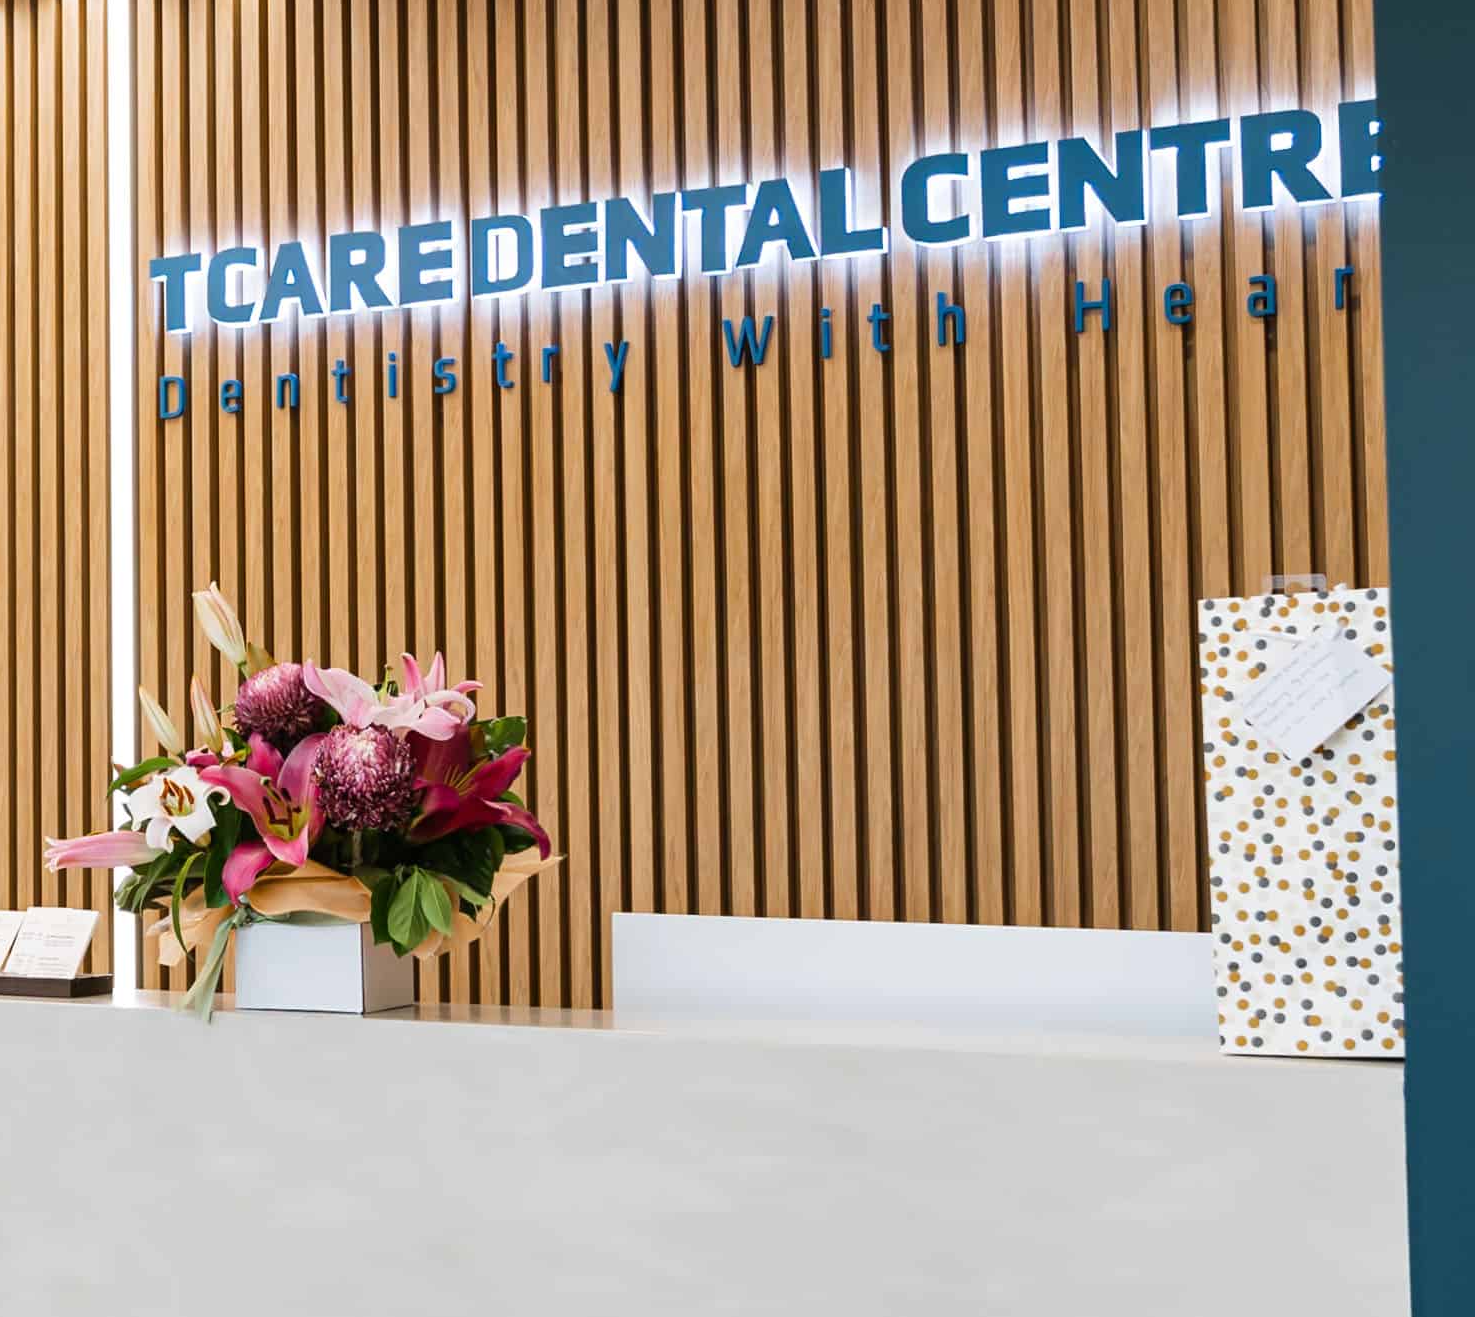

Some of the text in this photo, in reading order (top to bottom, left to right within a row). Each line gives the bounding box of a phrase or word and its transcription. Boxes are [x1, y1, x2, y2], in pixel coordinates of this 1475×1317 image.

[149, 220, 455, 334] TCARE
[470, 166, 888, 299] DENTAL
[158, 340, 630, 421] Dentistry
[722, 291, 967, 368] With
